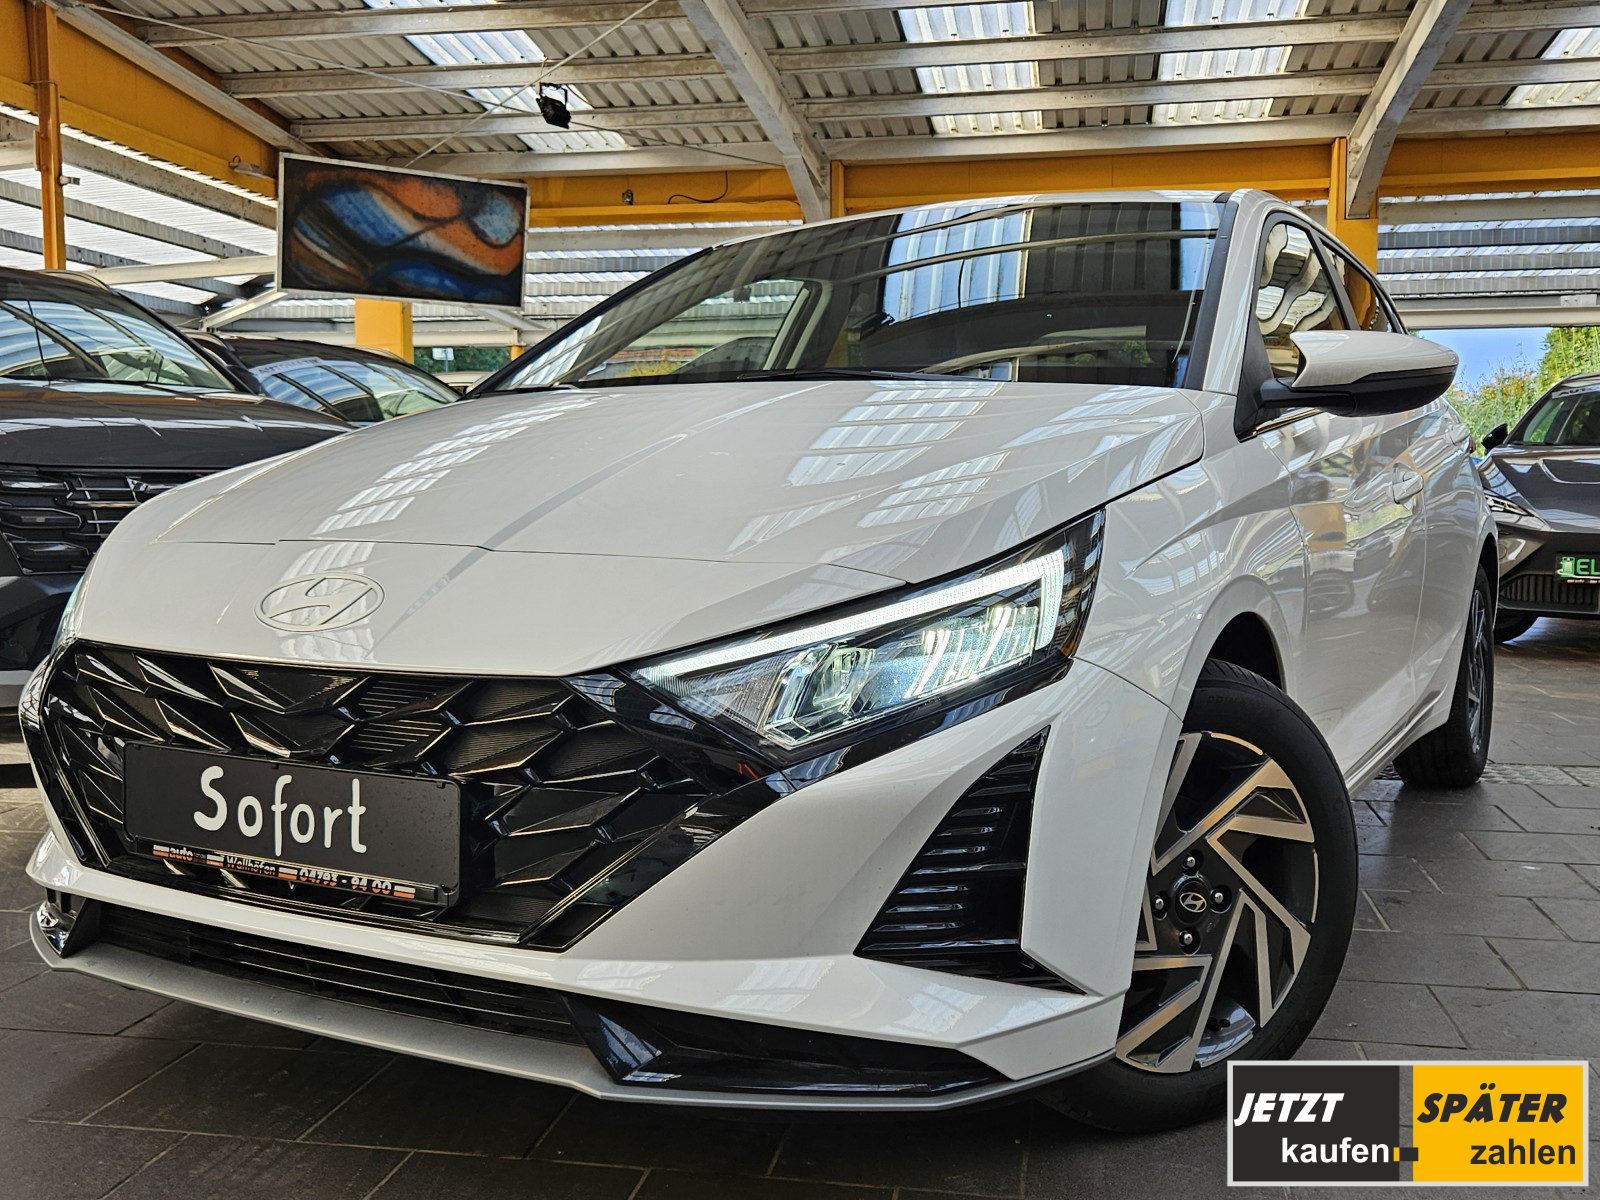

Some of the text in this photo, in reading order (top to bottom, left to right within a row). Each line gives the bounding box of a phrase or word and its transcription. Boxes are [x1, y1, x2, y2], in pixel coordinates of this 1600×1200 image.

[193, 765, 367, 857] Sofort
[169, 847, 194, 862] auto
[299, 867, 339, 887] 04793
[350, 876, 368, 892] 94
[371, 880, 392, 896] 00
